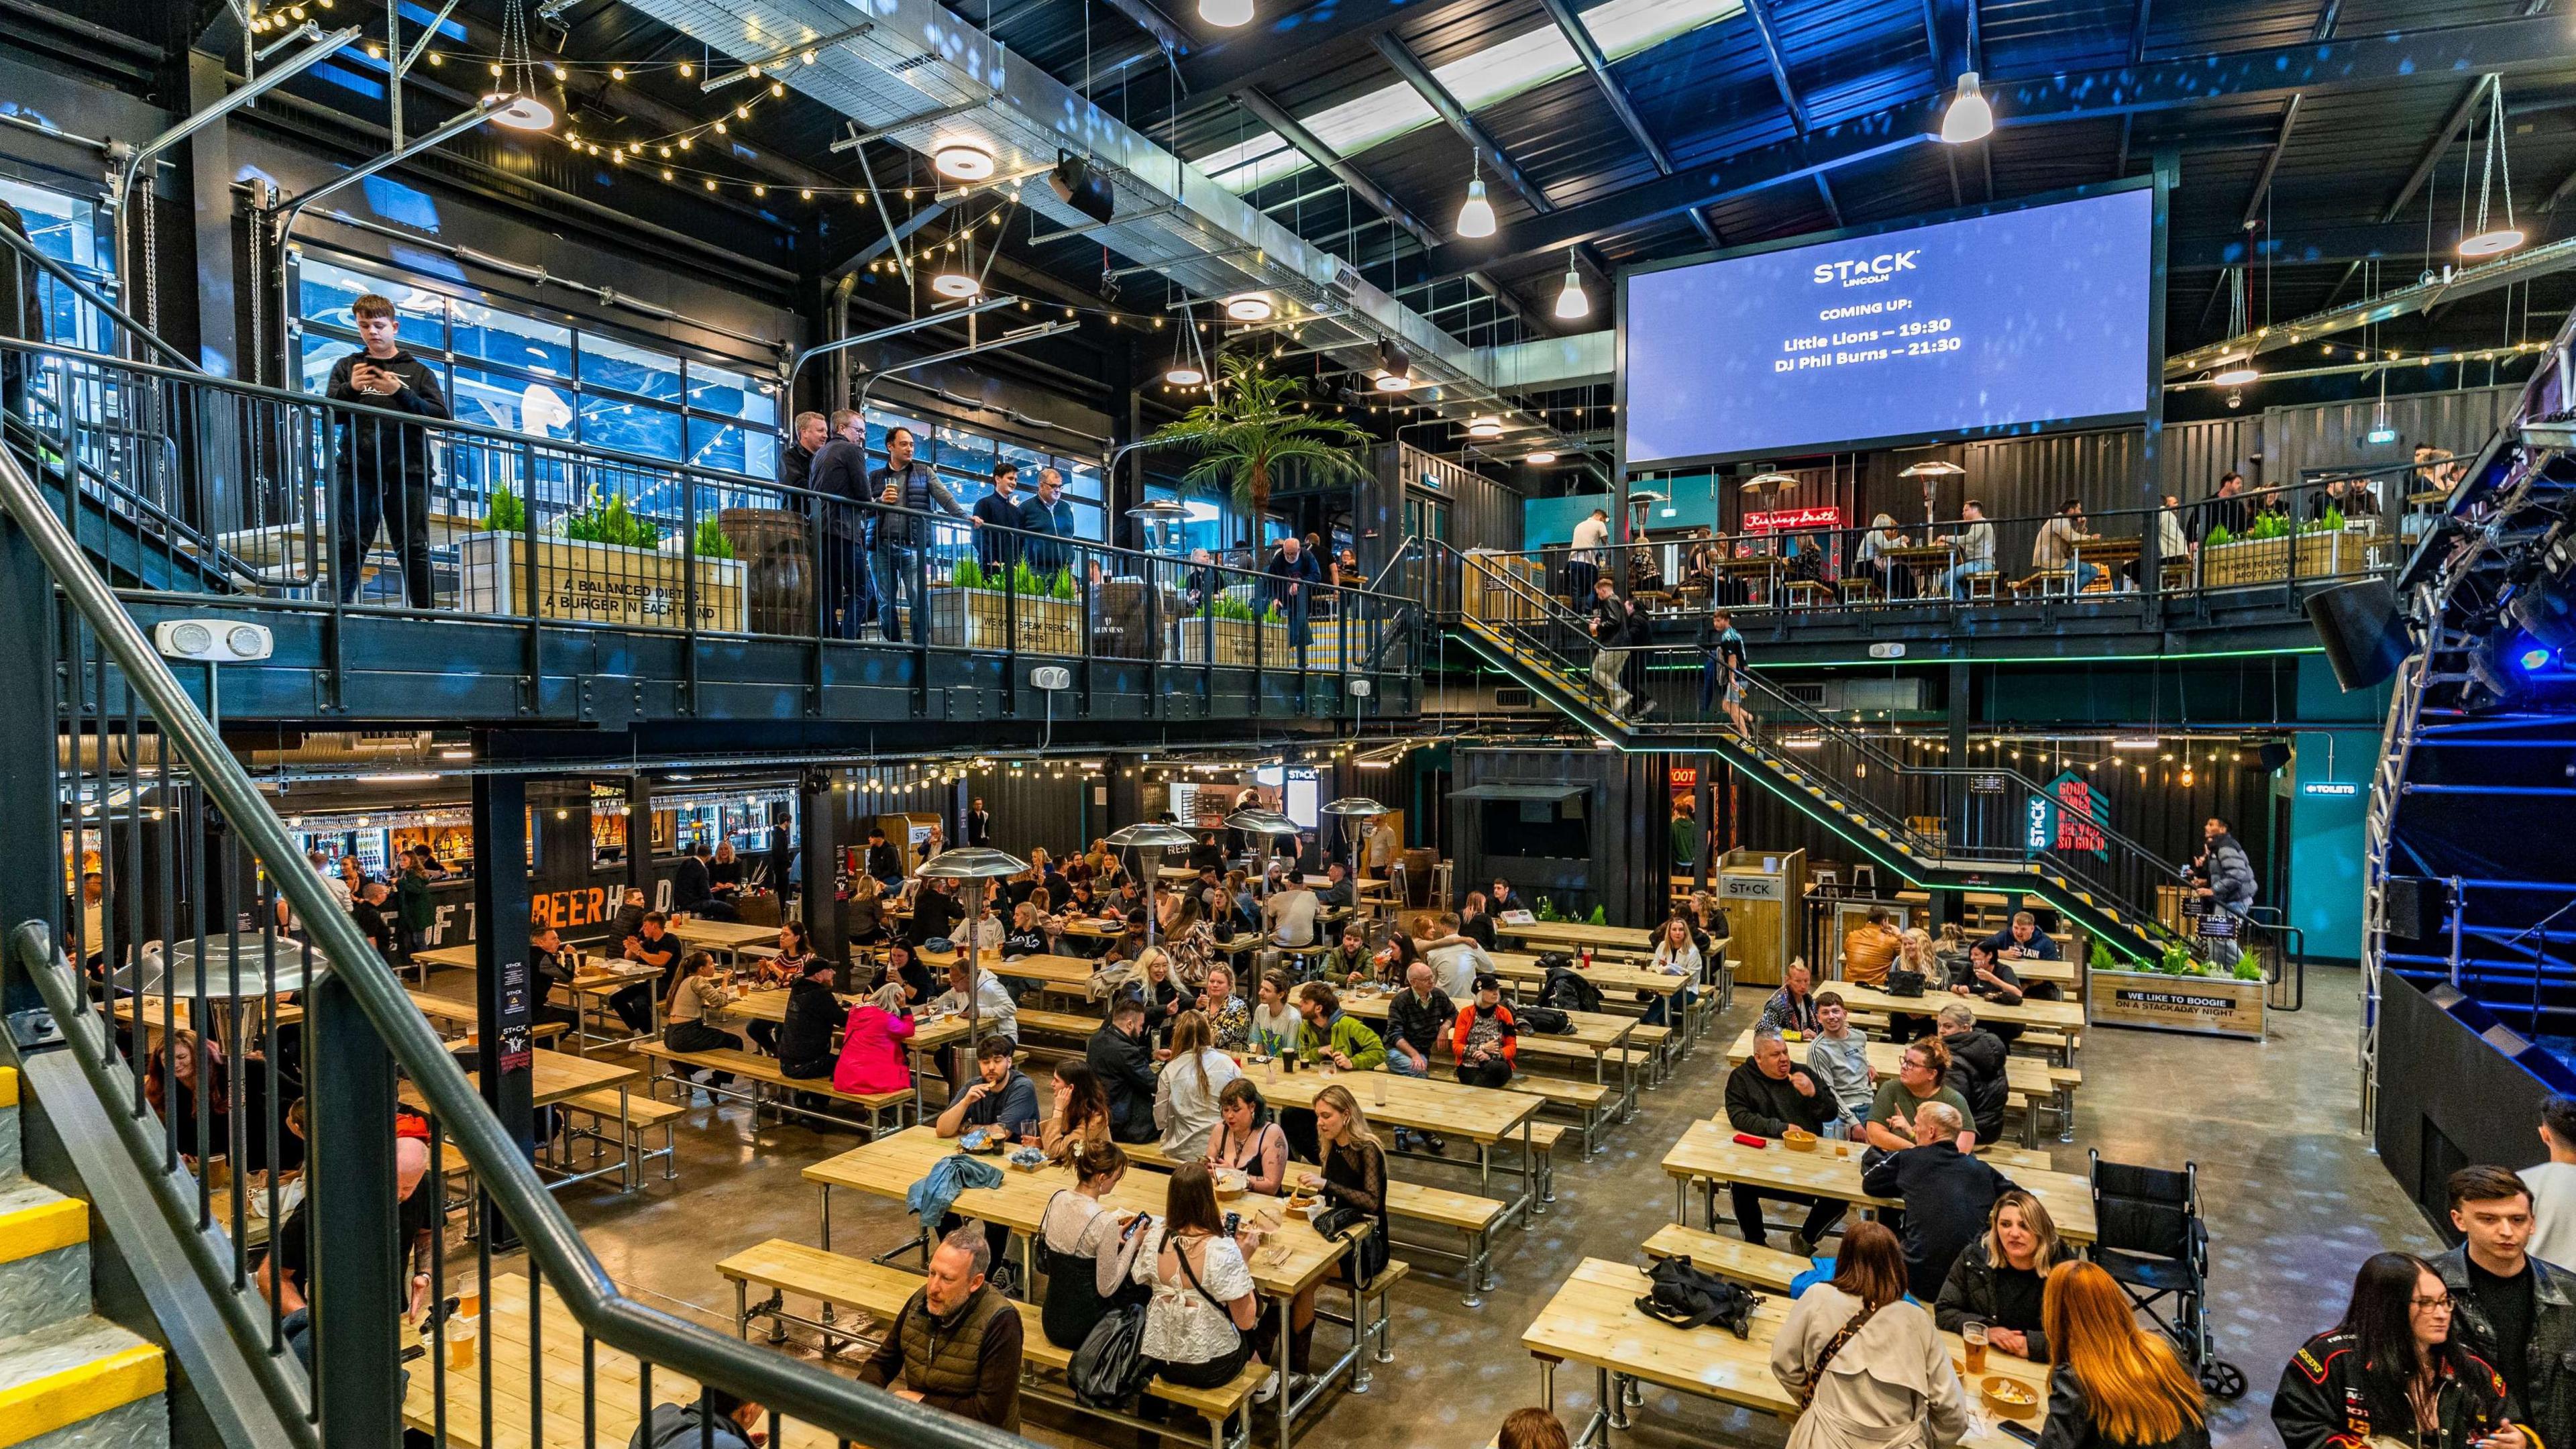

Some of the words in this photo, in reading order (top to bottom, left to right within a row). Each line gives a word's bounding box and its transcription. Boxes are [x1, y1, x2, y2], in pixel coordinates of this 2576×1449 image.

[1813, 250, 1917, 283] STACK
[1843, 274, 1889, 287] LINCOLN
[1819, 303, 1882, 321] COMING
[1886, 299, 1912, 311] UP:
[1784, 336, 1828, 352] Little
[1832, 330, 1878, 345] Lions
[1899, 319, 1951, 337] 19:30
[1775, 359, 1794, 372] DJ
[1799, 354, 1831, 370] Phil
[1836, 348, 1887, 365] Burns
[1908, 337, 1961, 356] 21:30
[1800, 511, 1837, 523] Booth
[2231, 562, 2251, 571] HERE
[2236, 570, 2262, 579] ABOUT
[564, 579, 574, 590] A
[578, 580, 651, 596] BALANCED
[655, 587, 683, 600] DIET
[545, 596, 555, 607] A
[560, 596, 619, 612] BURGER
[625, 602, 637, 613] N
[643, 603, 674, 616] EACH
[680, 606, 714, 619] HND
[984, 617, 996, 627] WE
[998, 618, 1017, 627] OY
[1019, 621, 1042, 631] SPEAK
[1288, 769, 1316, 779] STACK
[1672, 771, 1695, 782] OOT
[2059, 781, 2088, 796] GOOD
[2316, 785, 2355, 794] TOILETS
[2031, 800, 2045, 848] STACK
[915, 832, 931, 840] STAC
[1915, 838, 1946, 846] STCK
[2058, 836, 2072, 849] SO
[1167, 844, 1190, 855] FRESH
[1730, 883, 1769, 894] STACK
[2128, 991, 2143, 1000] WE
[2147, 994, 2167, 1002] LIKE
[2171, 996, 2184, 1004] TO
[2187, 998, 2226, 1008] BOOGIE
[2142, 1003, 2200, 1014] STACKADAY
[2202, 1008, 2234, 1017] NIGHT
[503, 1024, 527, 1034] STACK
